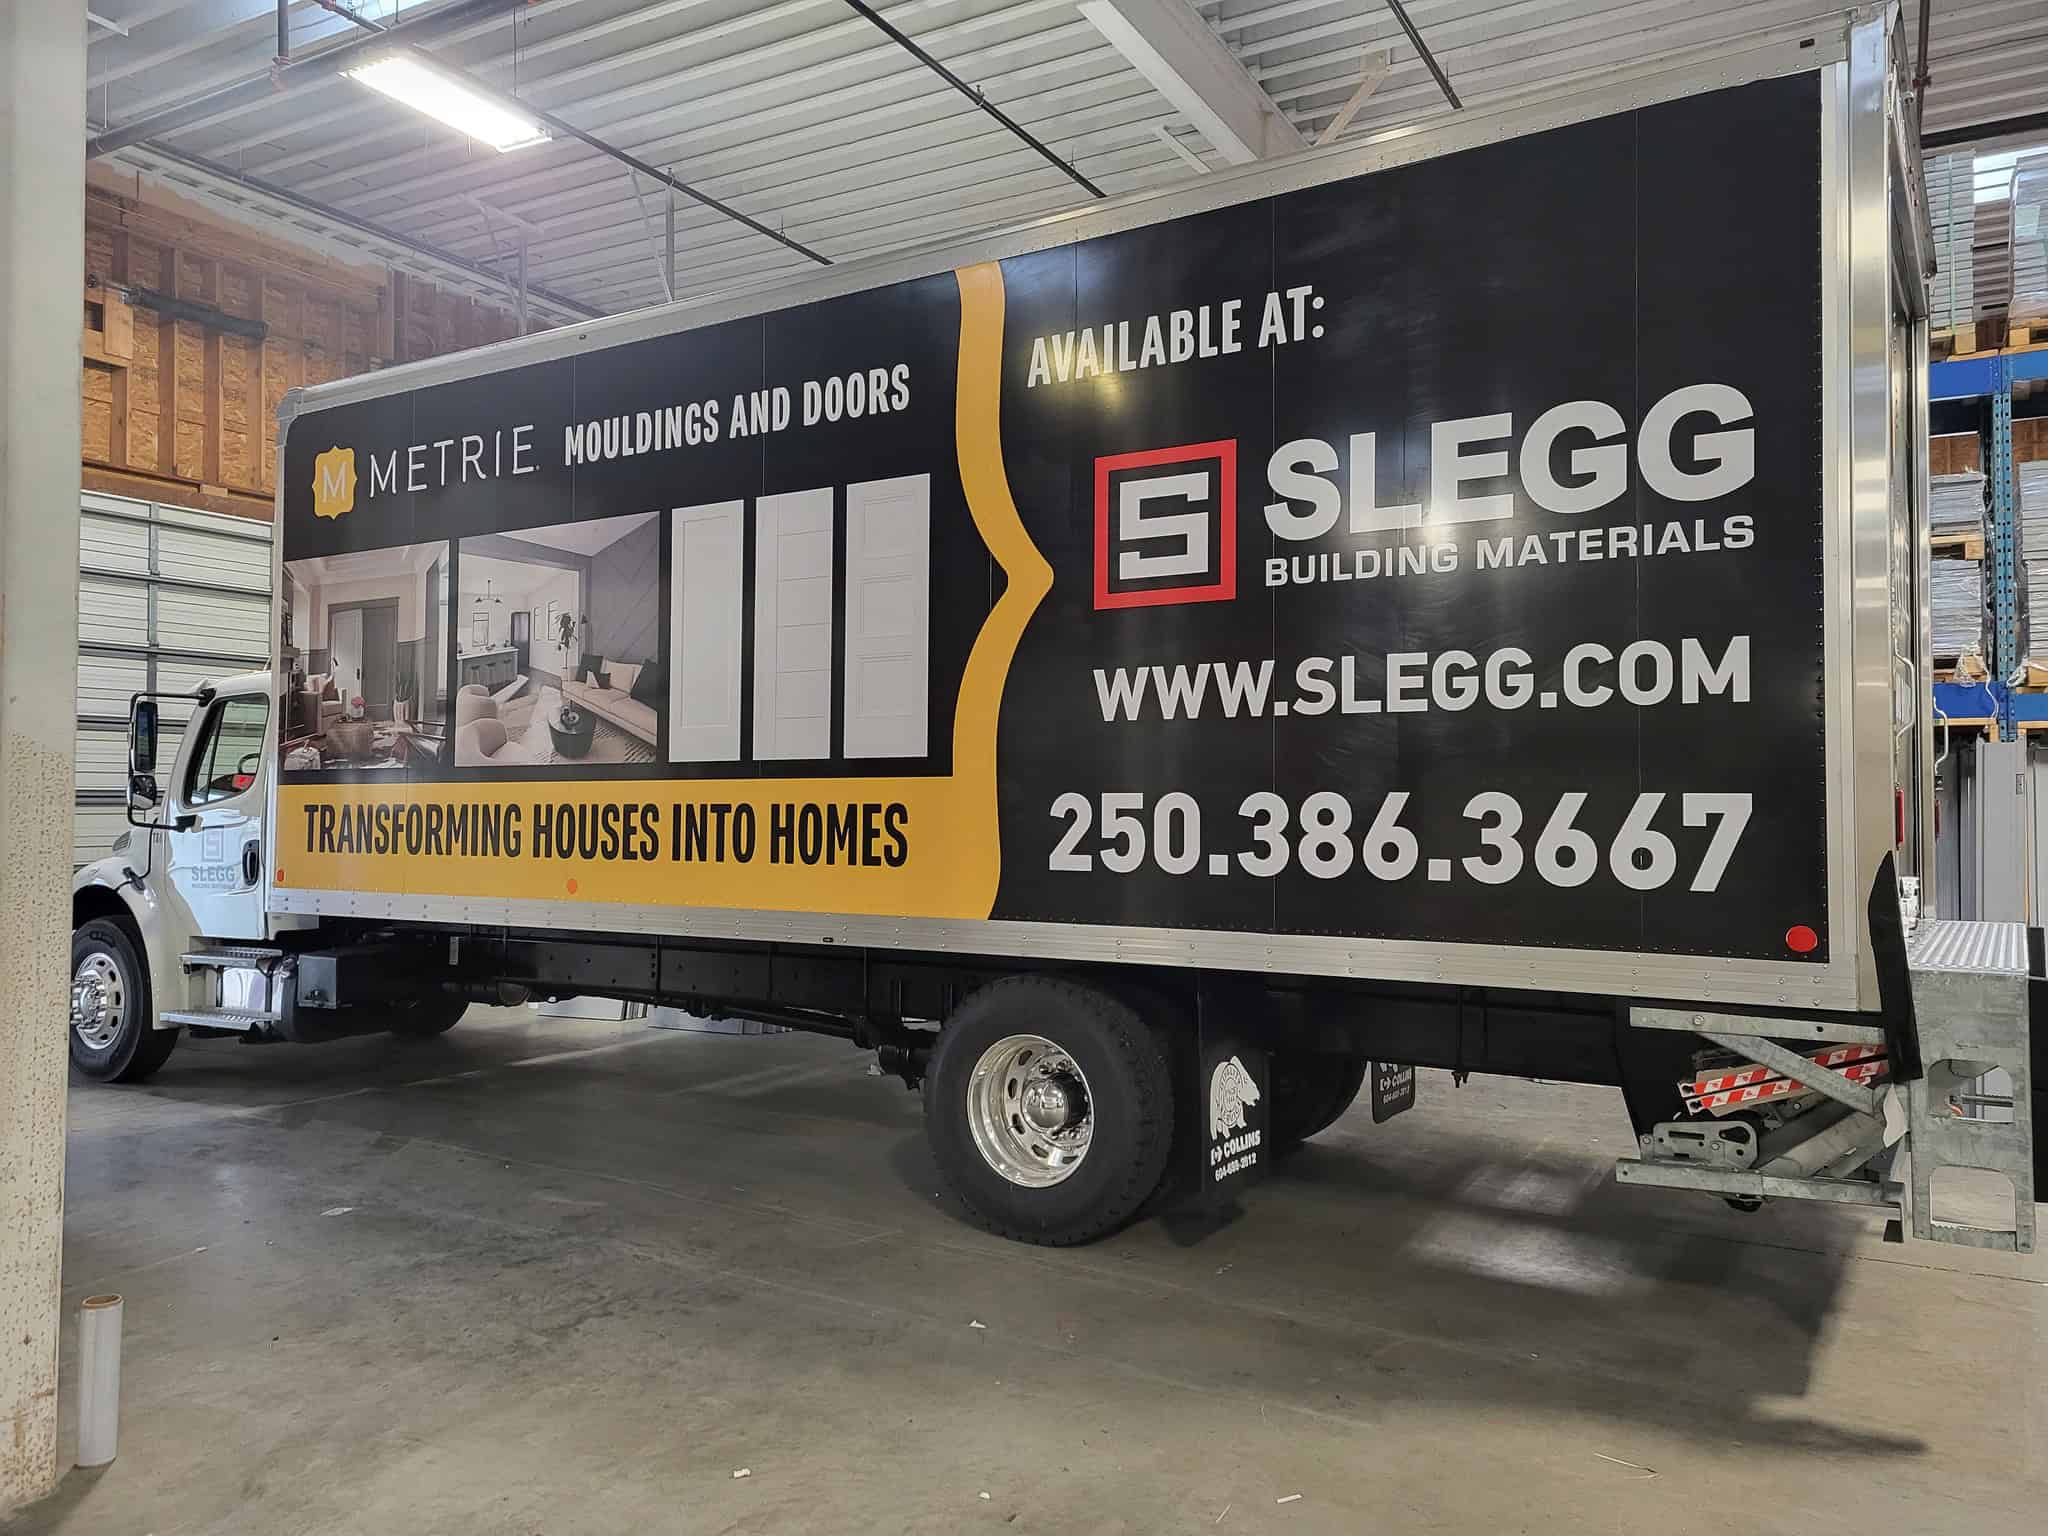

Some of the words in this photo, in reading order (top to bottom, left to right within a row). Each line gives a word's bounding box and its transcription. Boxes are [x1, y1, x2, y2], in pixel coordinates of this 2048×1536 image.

[1027, 299, 1243, 388] AVAILABLE
[1258, 285, 1325, 348] AT:
[566, 400, 718, 465] MOULDINGS
[730, 387, 790, 438] AND
[804, 364, 909, 425] DOORS
[323, 462, 348, 503] M
[1264, 384, 1755, 541] SLEGG
[1265, 542, 1458, 586] BUILDING
[1476, 515, 1755, 569] MATERIALS
[1094, 635, 1750, 722] WWW.SLEGG.COM
[192, 864, 235, 881] SLEGG
[304, 804, 521, 857] TRANSFORMING
[533, 804, 659, 861] HOUSES
[672, 803, 755, 863] INTO
[771, 803, 908, 867] HOMES
[1049, 791, 1753, 892] 250.386.3667
[1224, 1130, 1260, 1158] COLLINS
